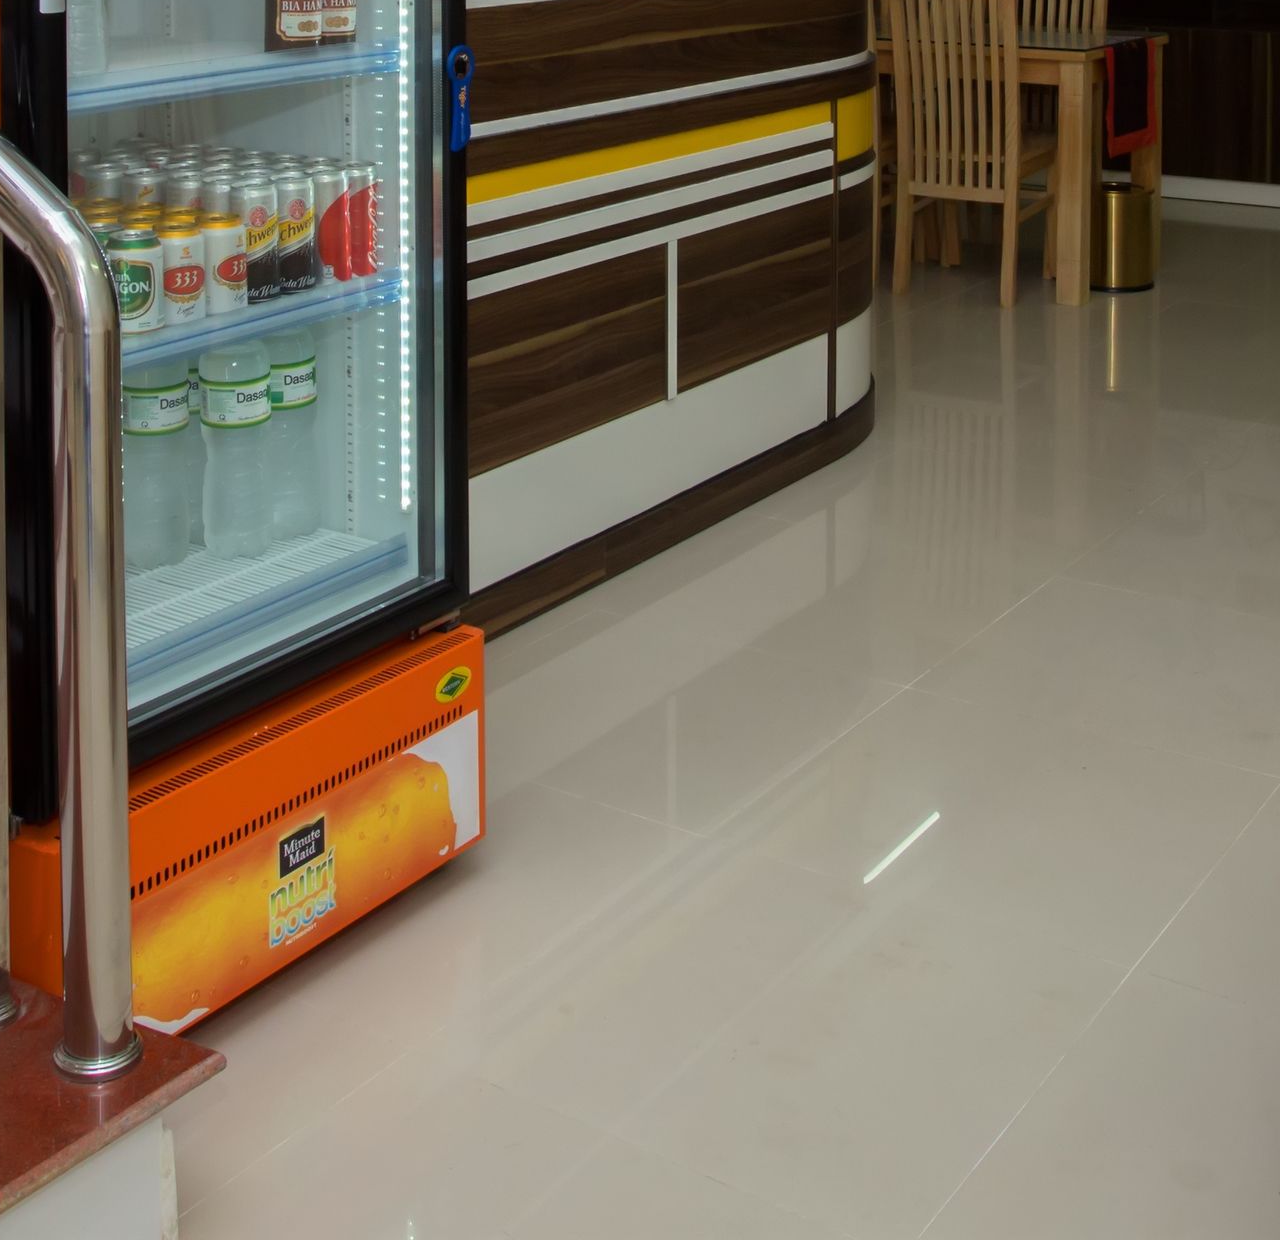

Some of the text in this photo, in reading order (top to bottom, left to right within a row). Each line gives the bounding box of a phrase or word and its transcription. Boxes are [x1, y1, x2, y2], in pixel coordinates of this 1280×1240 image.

[282, 0, 300, 12] BIA
[172, 270, 198, 289] 333
[283, 828, 322, 858] Minute
[289, 842, 317, 868] Maid
[269, 880, 337, 948] boost
